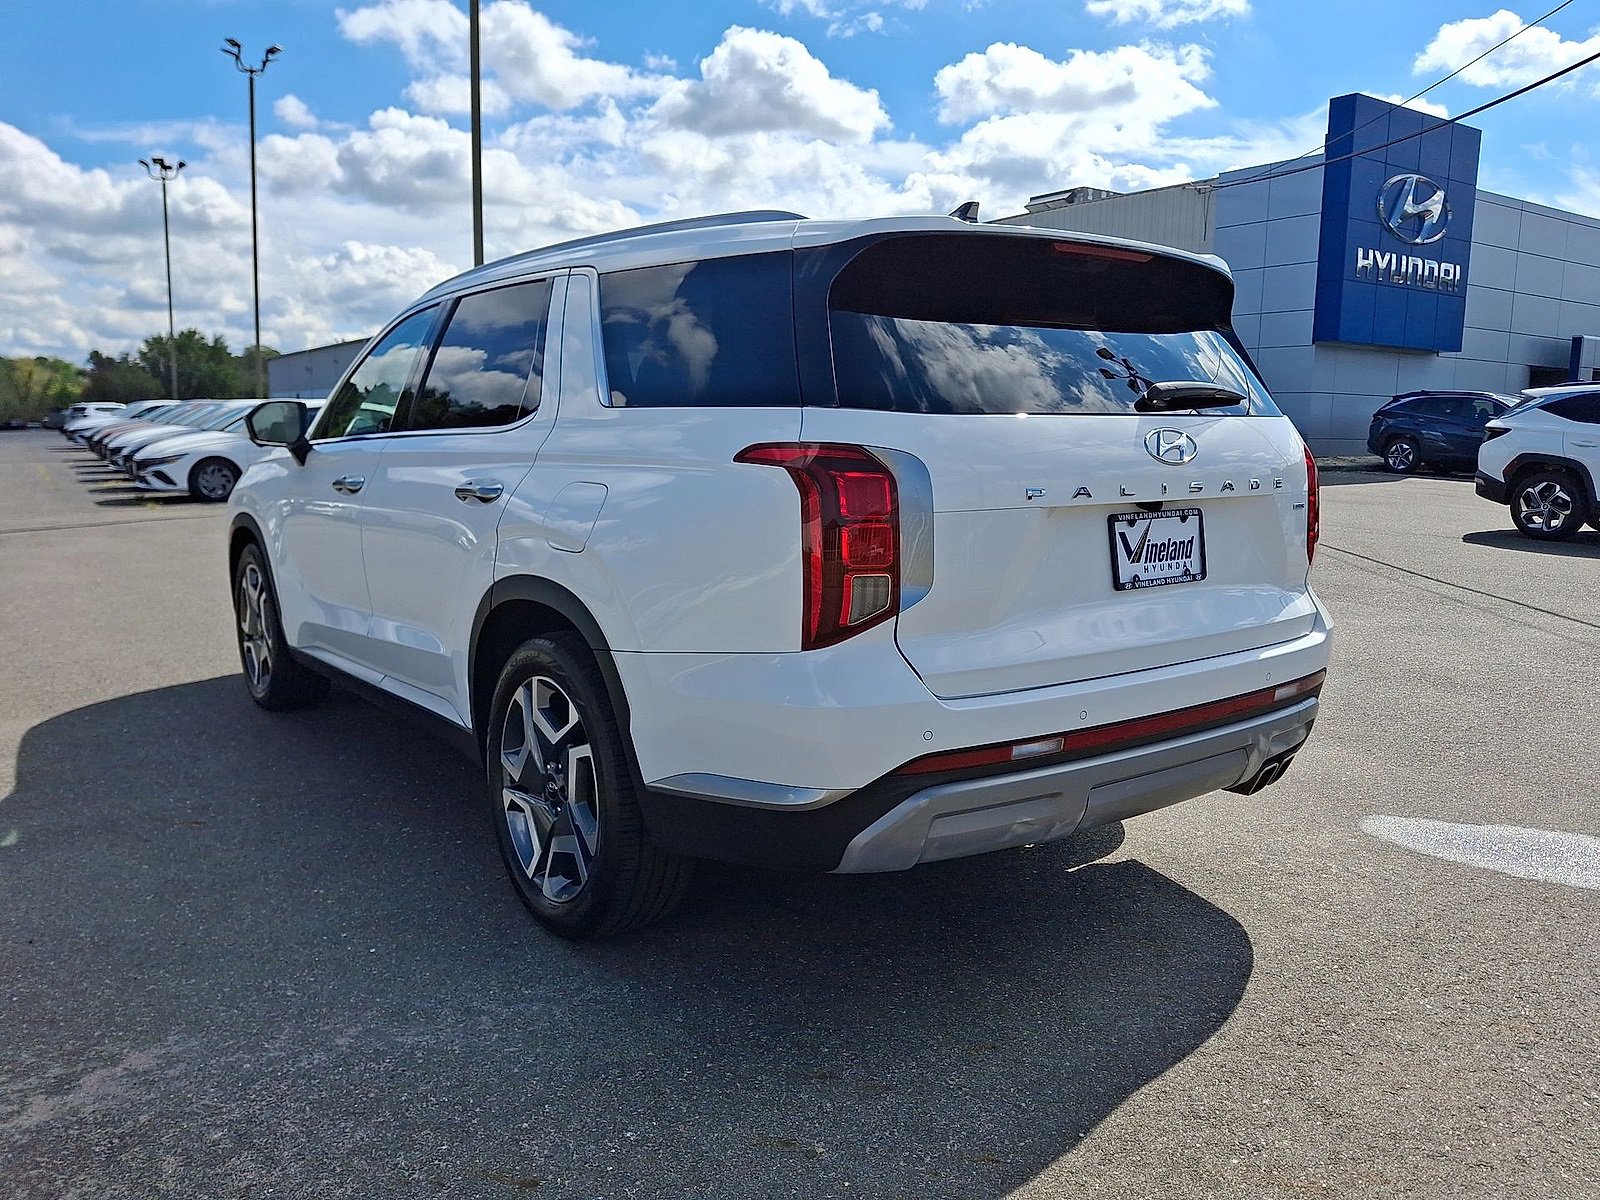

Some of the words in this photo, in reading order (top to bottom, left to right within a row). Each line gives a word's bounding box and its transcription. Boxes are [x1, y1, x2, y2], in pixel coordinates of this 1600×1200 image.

[1356, 247, 1462, 292] HYUNDAI
[1025, 476, 1284, 501] PALISADE
[1118, 509, 1199, 520] VINELANDHYUNDAI.COM
[1118, 519, 1195, 564] Vineland
[1144, 560, 1193, 573] HYUNDAI
[1134, 579, 1165, 588] VINELAND
[1166, 575, 1193, 585] HYUNDAI
